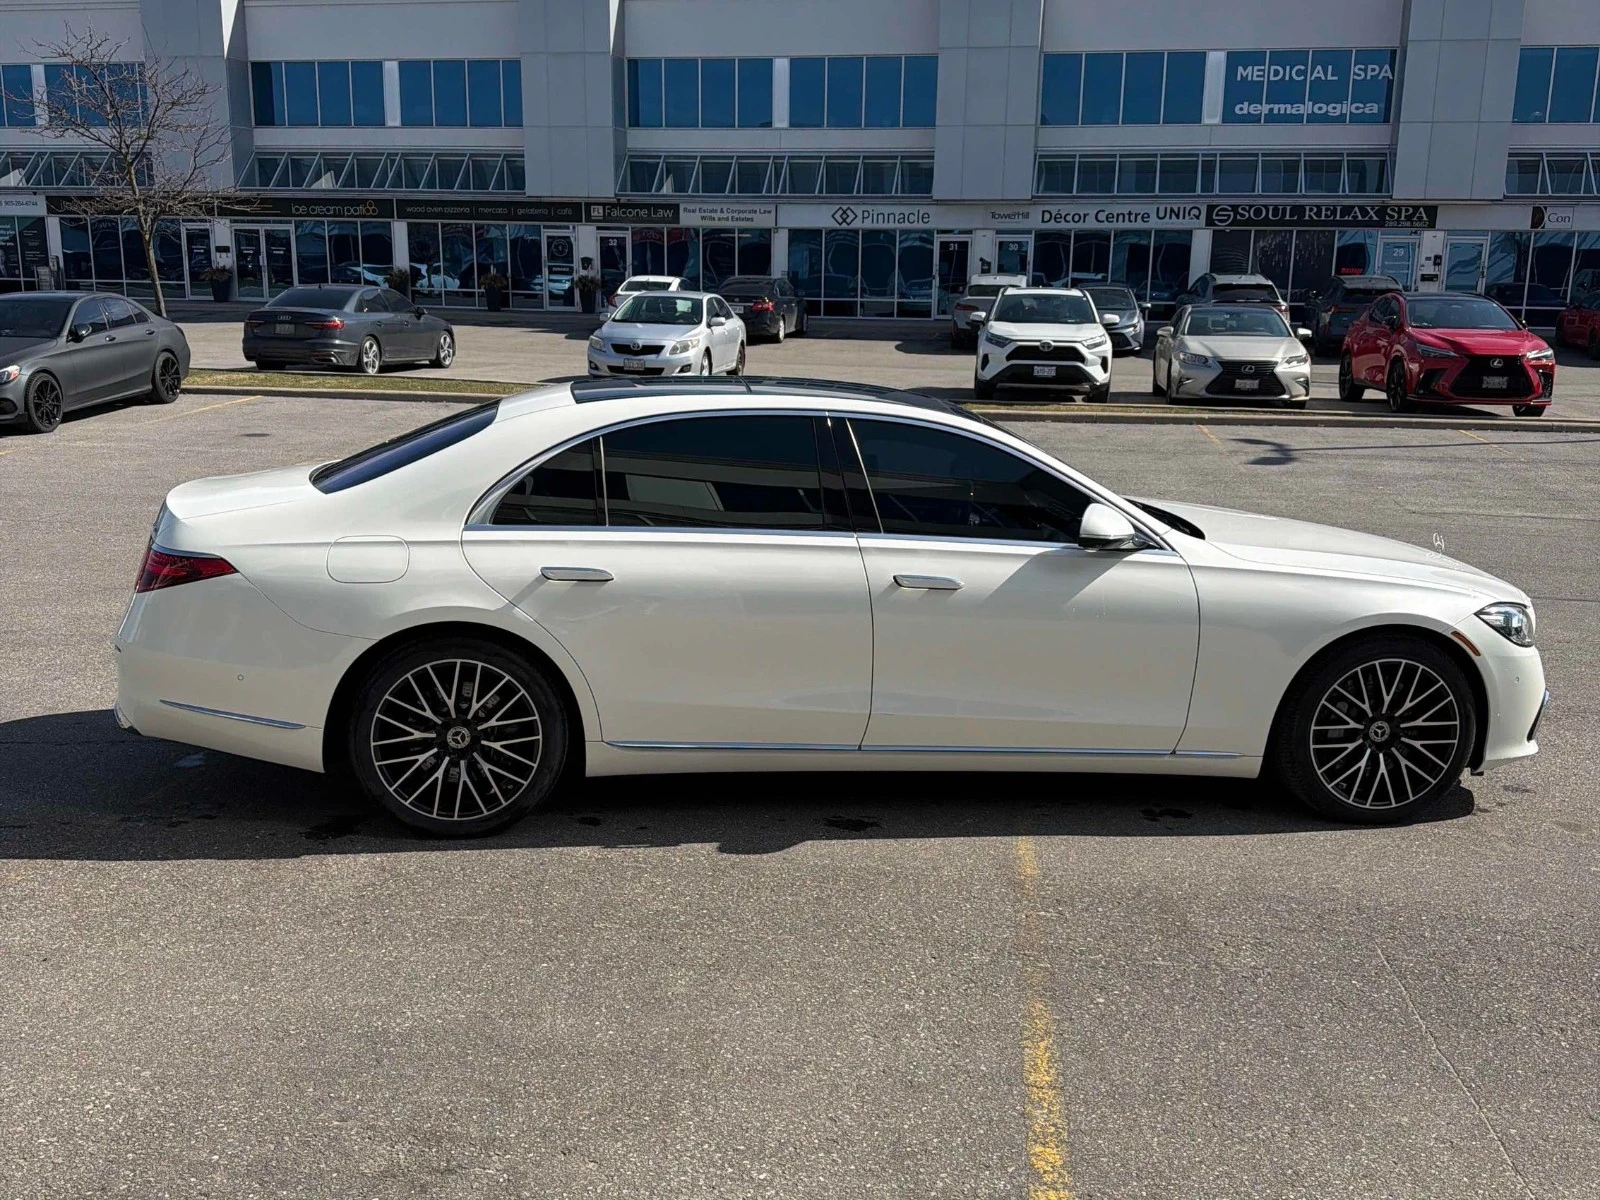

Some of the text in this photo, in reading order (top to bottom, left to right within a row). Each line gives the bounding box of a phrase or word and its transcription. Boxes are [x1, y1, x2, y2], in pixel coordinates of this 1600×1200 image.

[1236, 64, 1393, 81] MEDICAL SPA
[1234, 101, 1378, 116] dermalogica
[291, 203, 307, 215] ice
[309, 205, 343, 215] cream
[443, 206, 470, 214] pizzeria
[517, 207, 549, 216] gelateria
[605, 206, 674, 218] Falcone Law
[726, 207, 757, 215] Corporate
[1156, 206, 1202, 220] UNIQ
[1236, 205, 1429, 221] SOUL RELAX SPA
[861, 209, 931, 225] Pinnacle
[1041, 208, 1151, 224] Décor Centre
[1547, 212, 1571, 223] Con
[1393, 248, 1404, 256] 29
